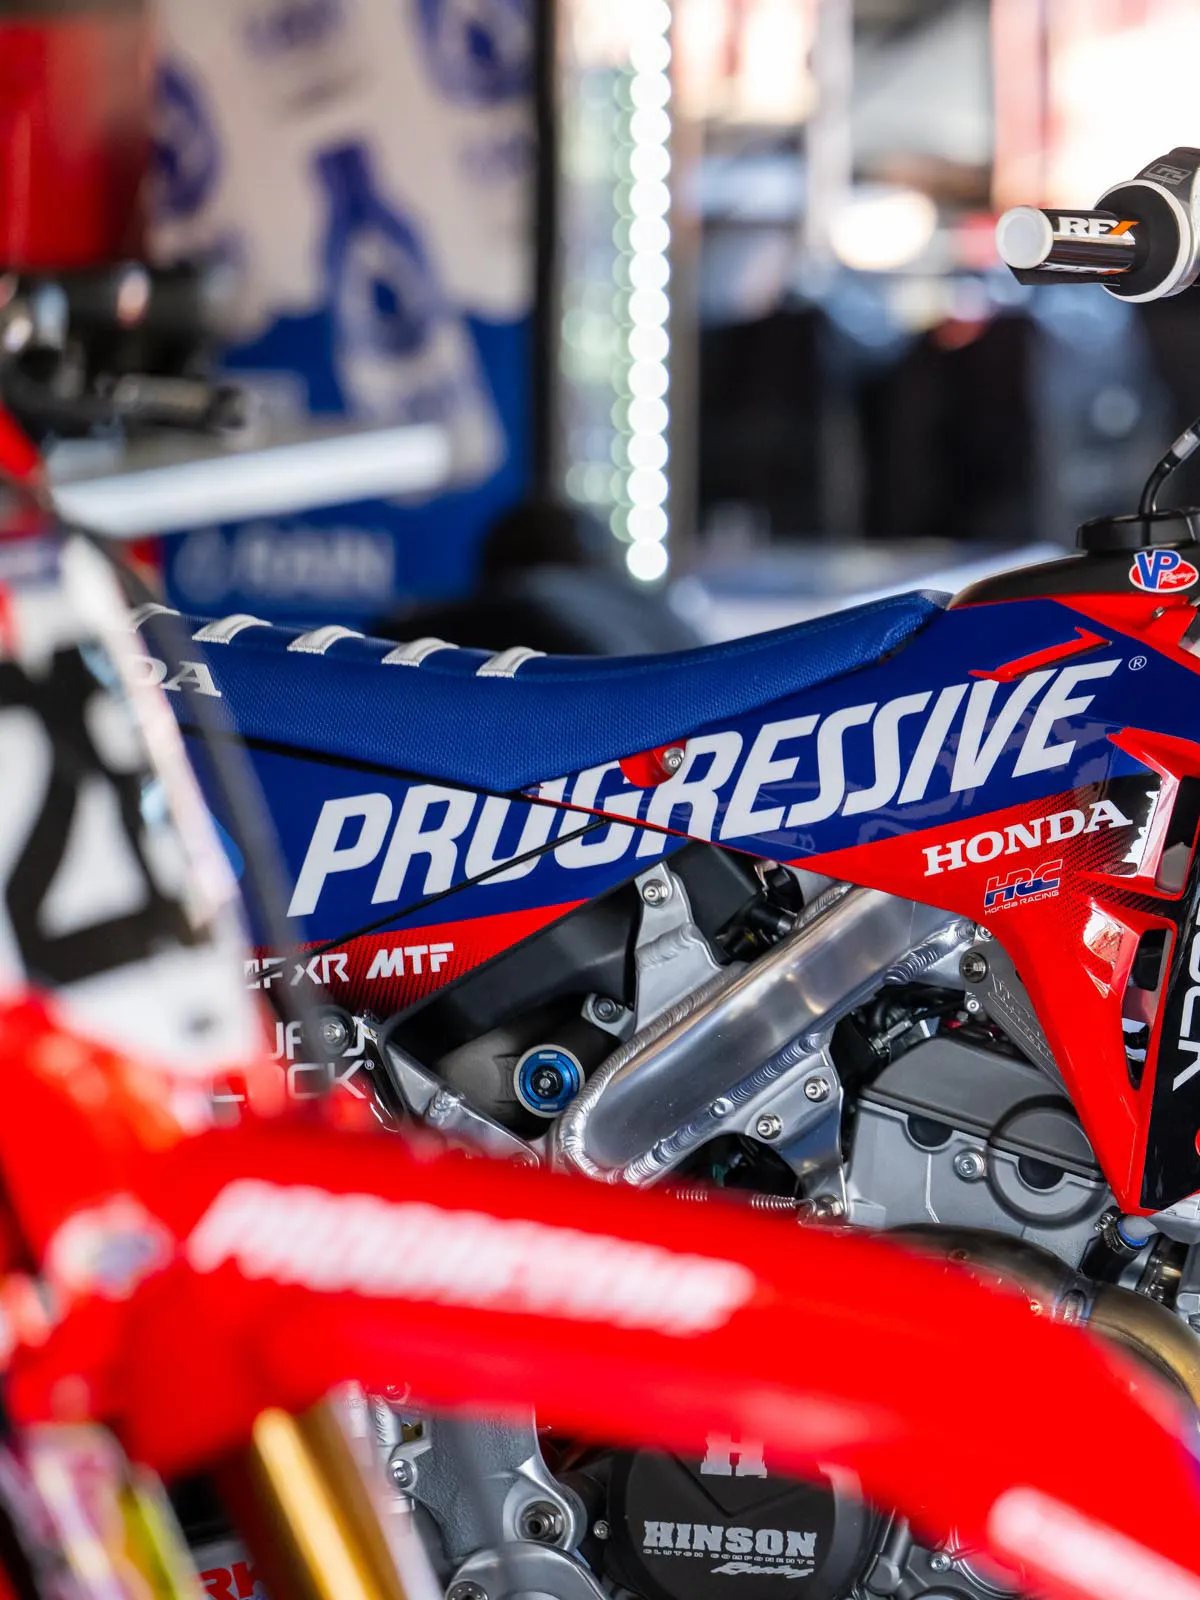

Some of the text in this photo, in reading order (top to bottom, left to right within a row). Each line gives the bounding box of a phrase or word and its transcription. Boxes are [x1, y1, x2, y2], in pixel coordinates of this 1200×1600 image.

[1057, 215, 1141, 245] RFX
[1134, 549, 1182, 590] VP
[922, 800, 1133, 876] HONDA
[984, 858, 1063, 908] HRC
[365, 942, 454, 980] MTF
[643, 1521, 818, 1557] HINSON
